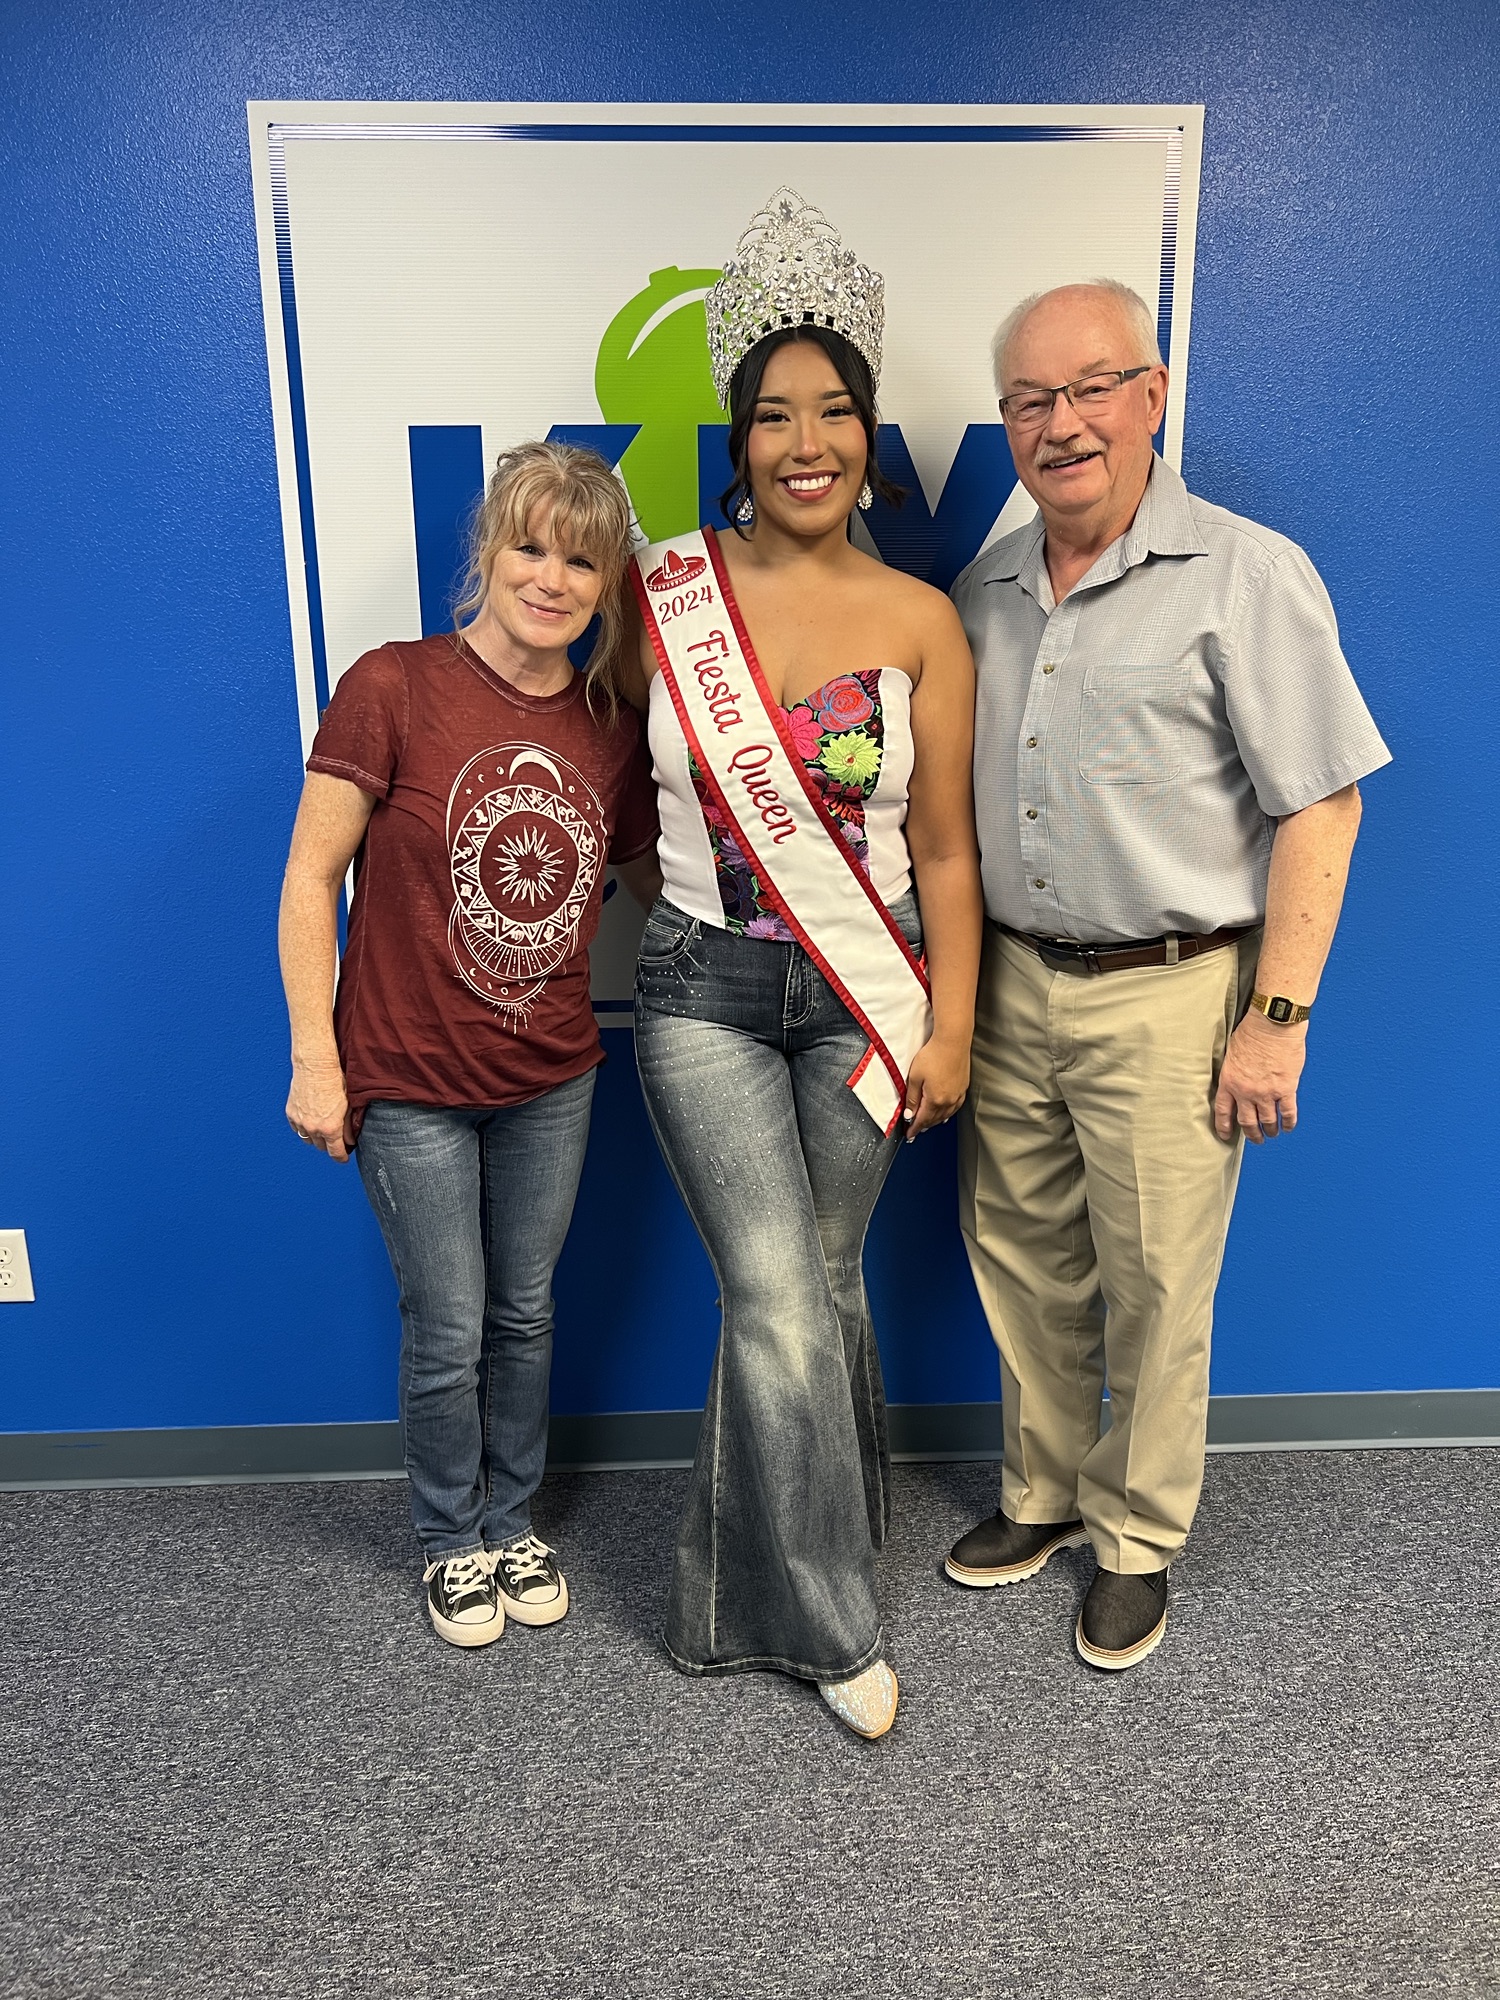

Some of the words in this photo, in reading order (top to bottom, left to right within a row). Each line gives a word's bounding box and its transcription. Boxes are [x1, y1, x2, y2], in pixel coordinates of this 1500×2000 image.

[658, 585, 714, 625] 2024
[687, 629, 744, 734] Fiesta
[727, 744, 797, 845] Queen
